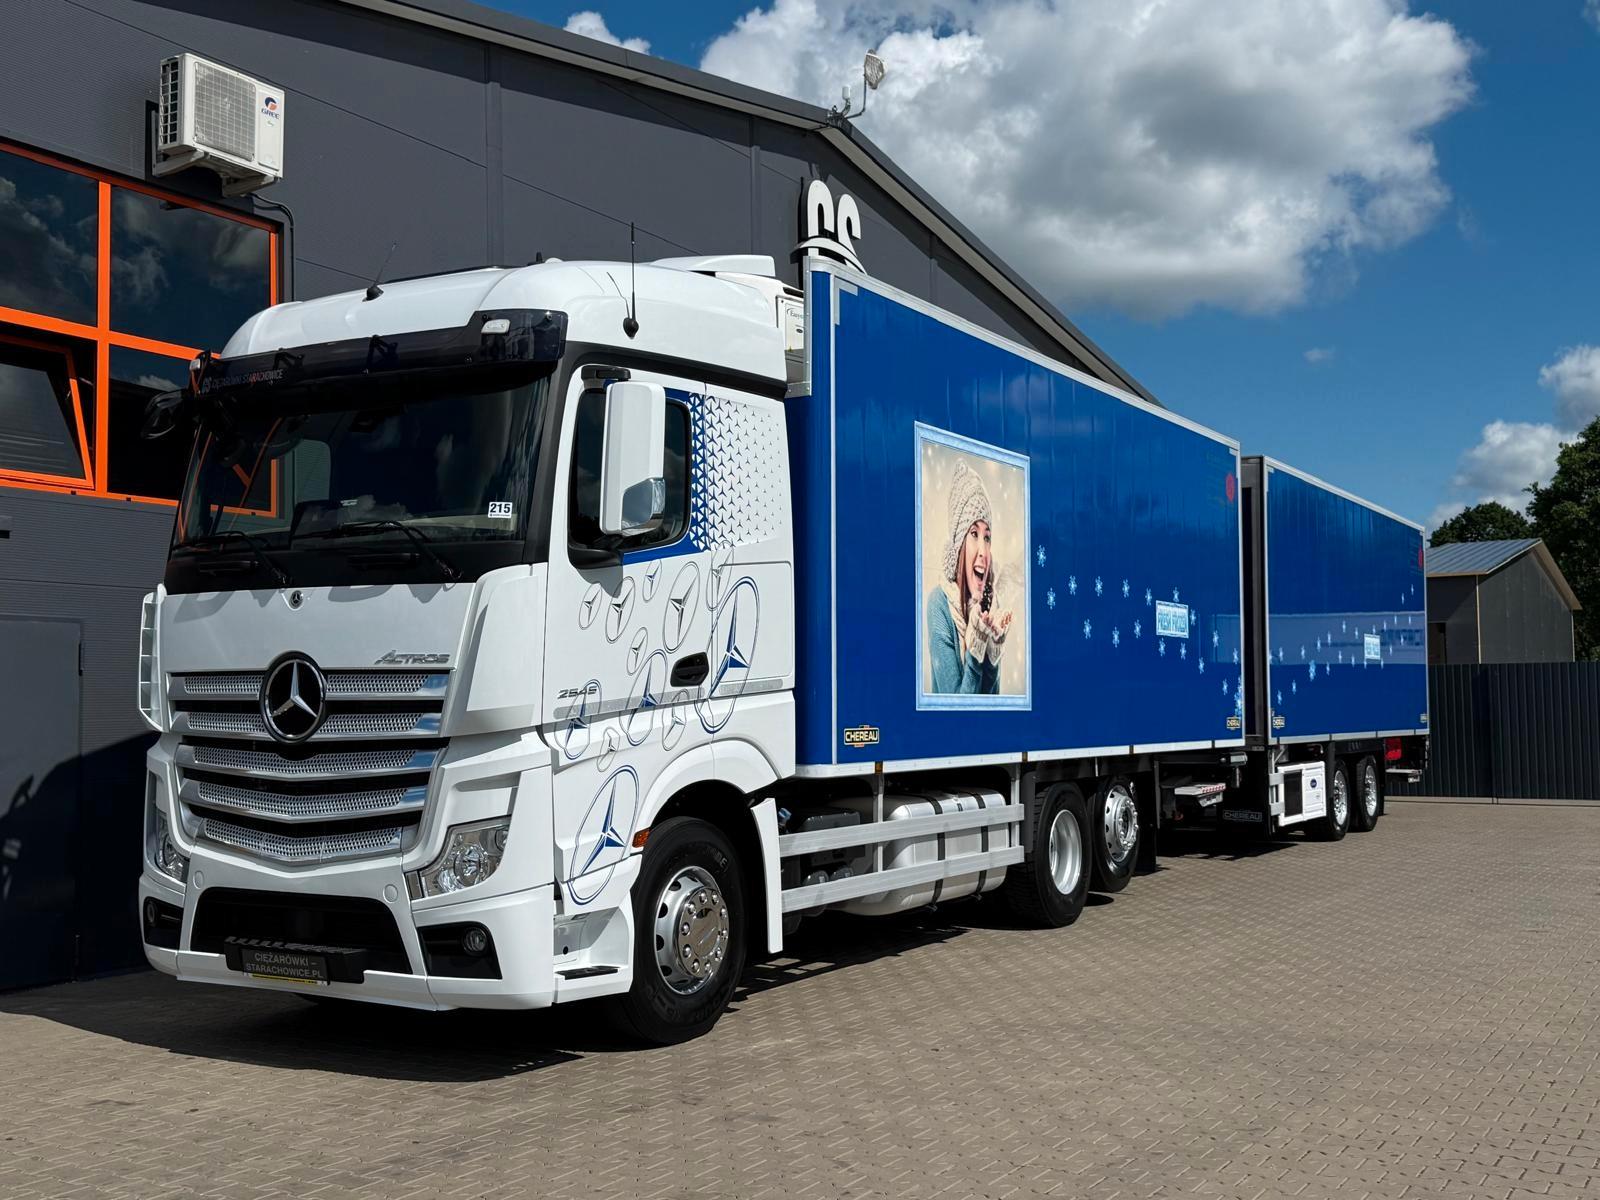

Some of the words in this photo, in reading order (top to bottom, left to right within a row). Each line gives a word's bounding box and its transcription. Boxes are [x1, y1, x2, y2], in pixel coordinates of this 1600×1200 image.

[490, 503, 511, 514] 215
[557, 685, 597, 699] 2545
[845, 730, 878, 742] CHEREAU
[254, 951, 309, 967] CIĘŻARÓWKI
[246, 962, 323, 979] STARACHOWICE.PL
